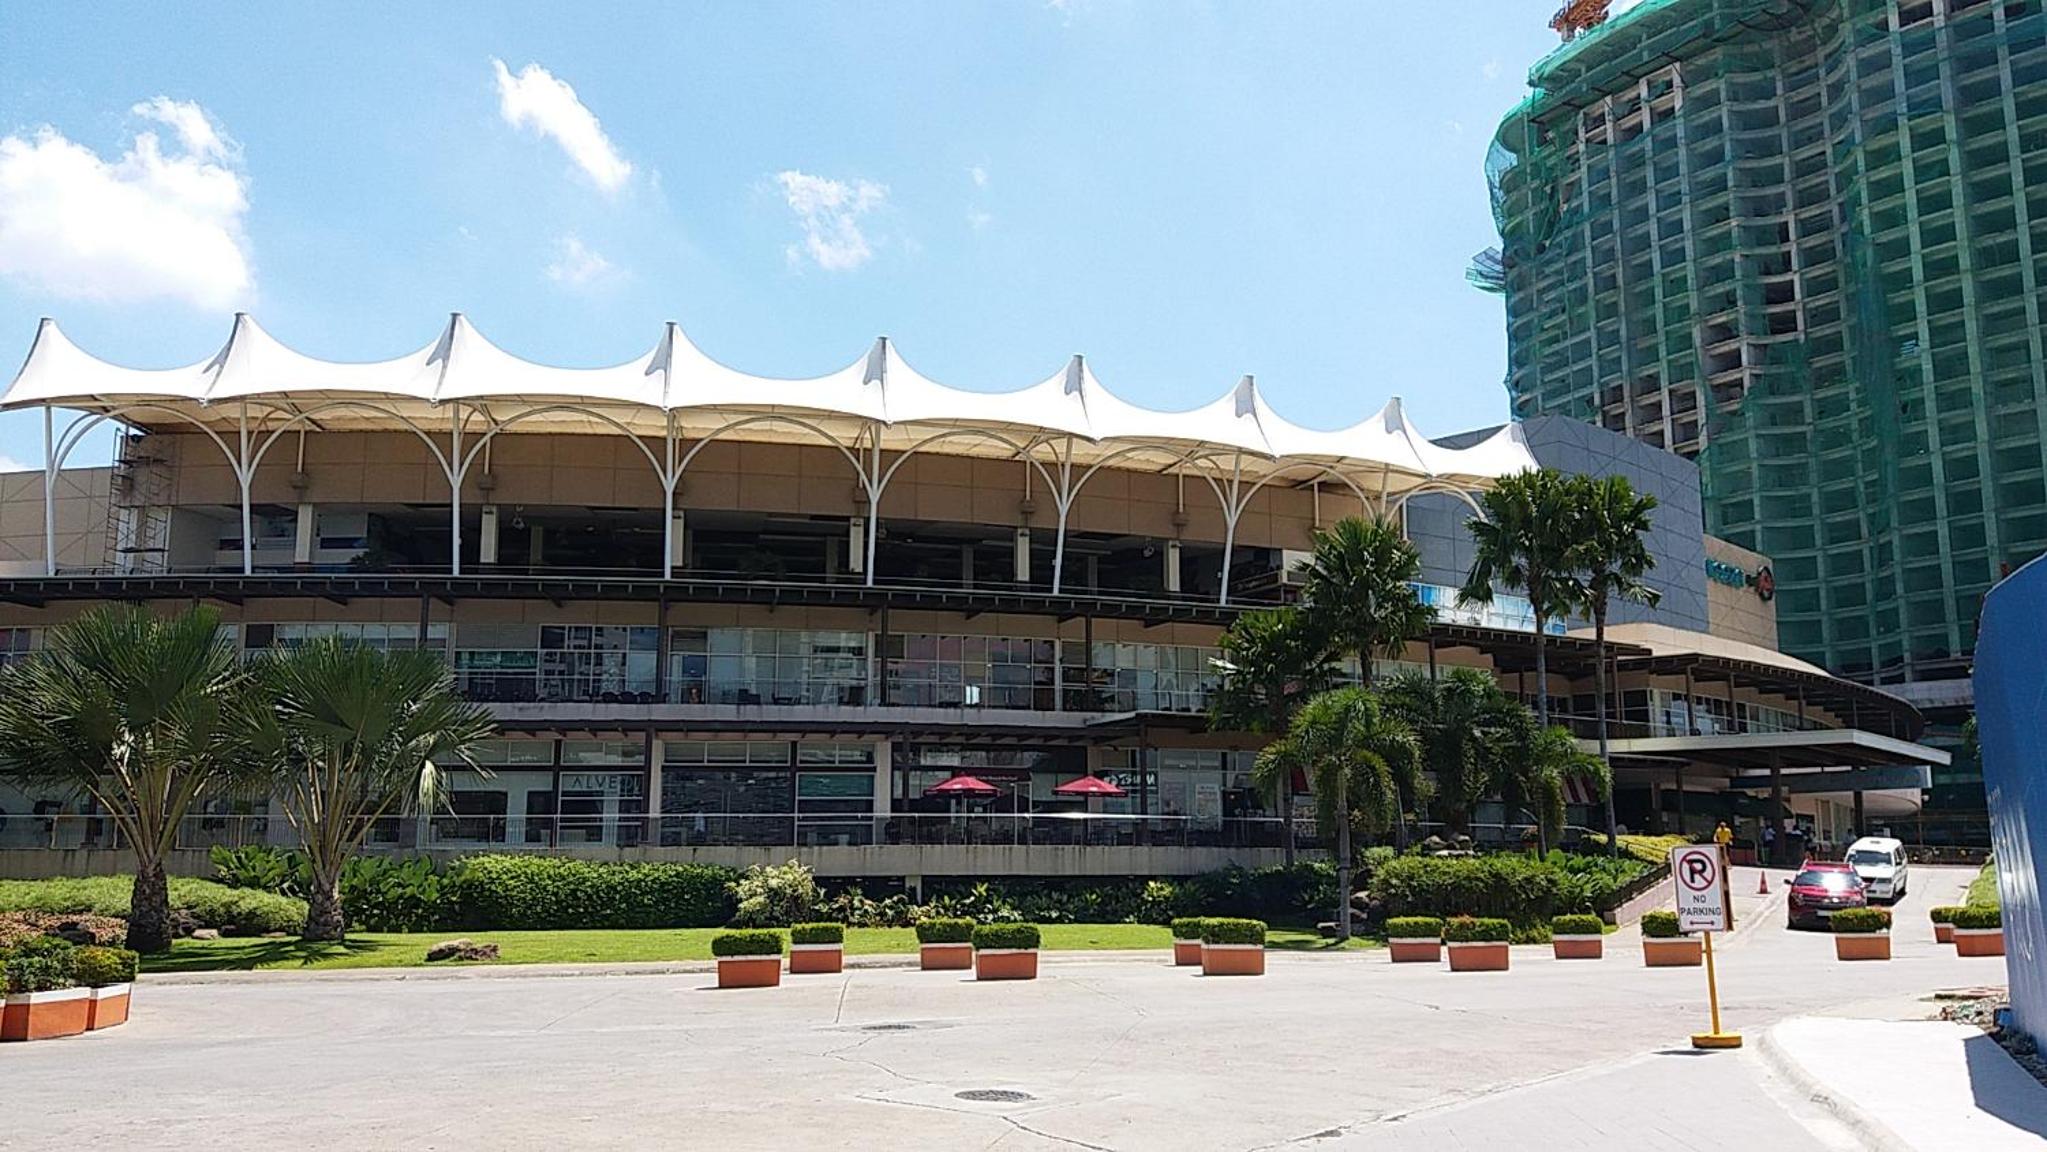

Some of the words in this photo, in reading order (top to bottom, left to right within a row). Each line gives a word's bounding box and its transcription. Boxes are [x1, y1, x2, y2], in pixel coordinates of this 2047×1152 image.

[1689, 859, 1706, 883] P
[1693, 895, 1706, 903] NO
[1680, 907, 1721, 916] PARKING
